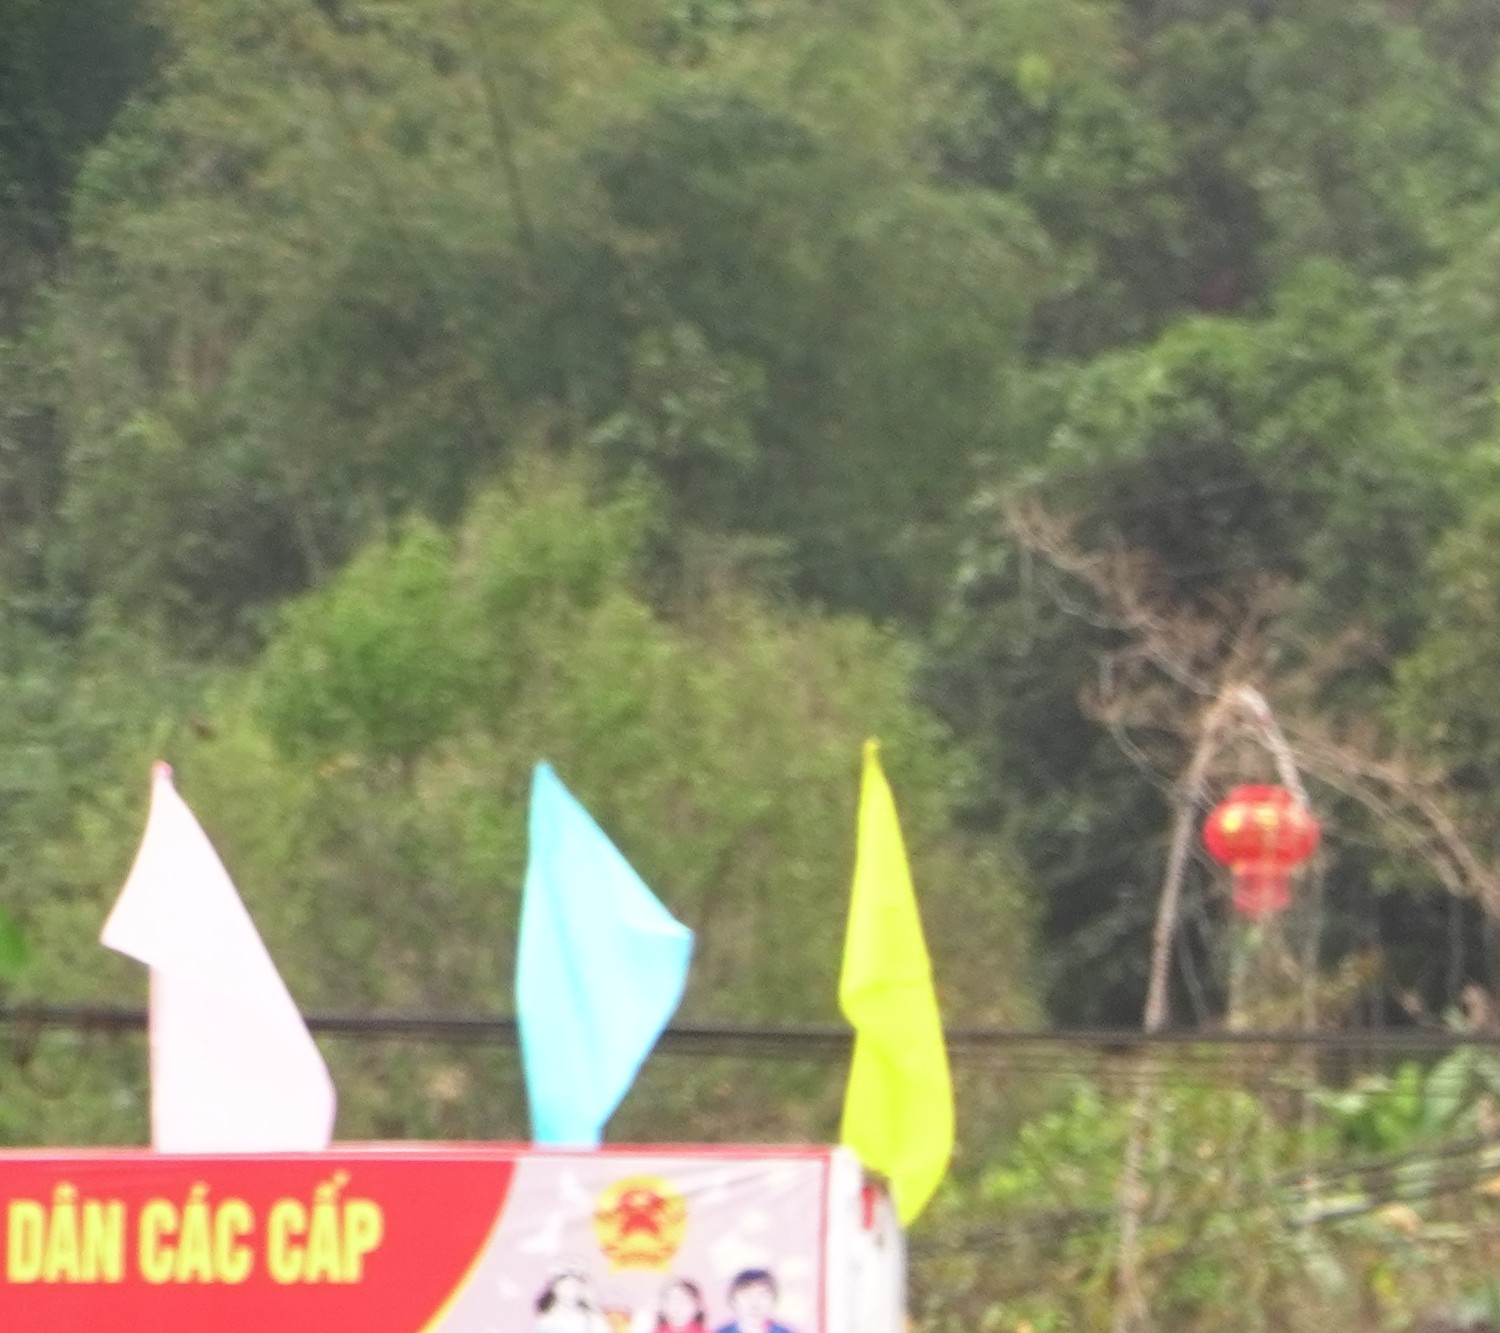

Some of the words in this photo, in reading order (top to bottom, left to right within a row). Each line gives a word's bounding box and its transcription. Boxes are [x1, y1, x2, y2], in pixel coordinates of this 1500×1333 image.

[7, 1180, 126, 1284] DÂN
[139, 1179, 255, 1285] CÁC
[266, 1168, 385, 1285] CẤP
